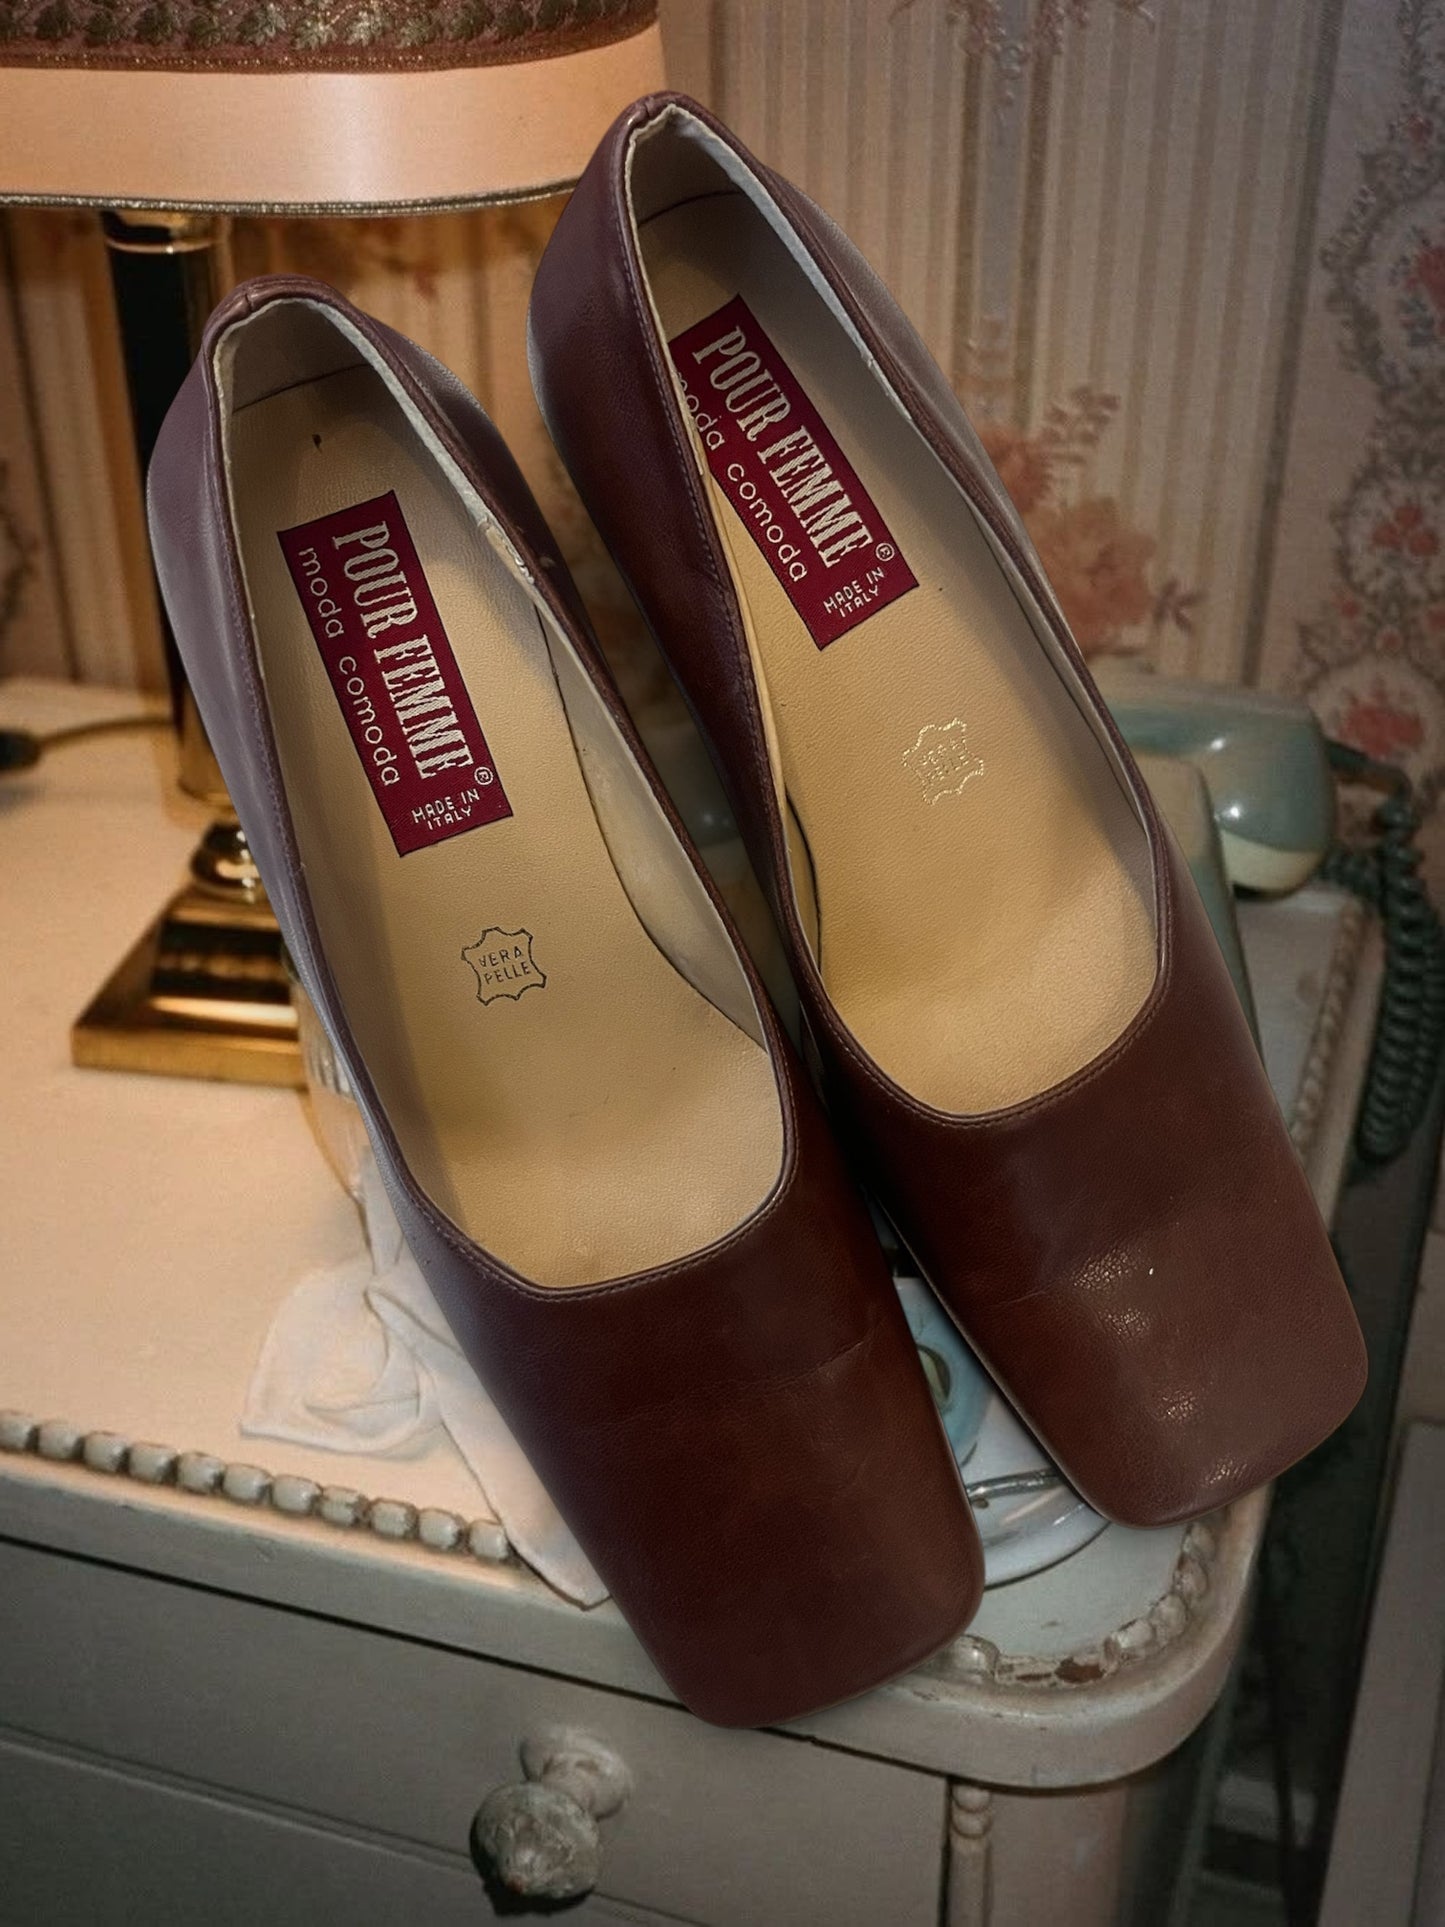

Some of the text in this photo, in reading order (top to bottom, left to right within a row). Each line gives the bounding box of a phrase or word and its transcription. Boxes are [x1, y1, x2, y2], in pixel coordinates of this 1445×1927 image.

[692, 326, 792, 442] POUR
[757, 425, 874, 569] FEMME
[727, 463, 808, 583] comoda
[332, 520, 419, 639] POUR
[823, 566, 885, 614] MADE IN
[839, 586, 881, 618] ITALY
[299, 547, 400, 786] moda comoda
[374, 634, 474, 779] FEMME
[411, 788, 480, 824] MADE IN
[427, 805, 473, 830] ITALY
[479, 946, 523, 967] VERA
[484, 961, 531, 984] PELLE
